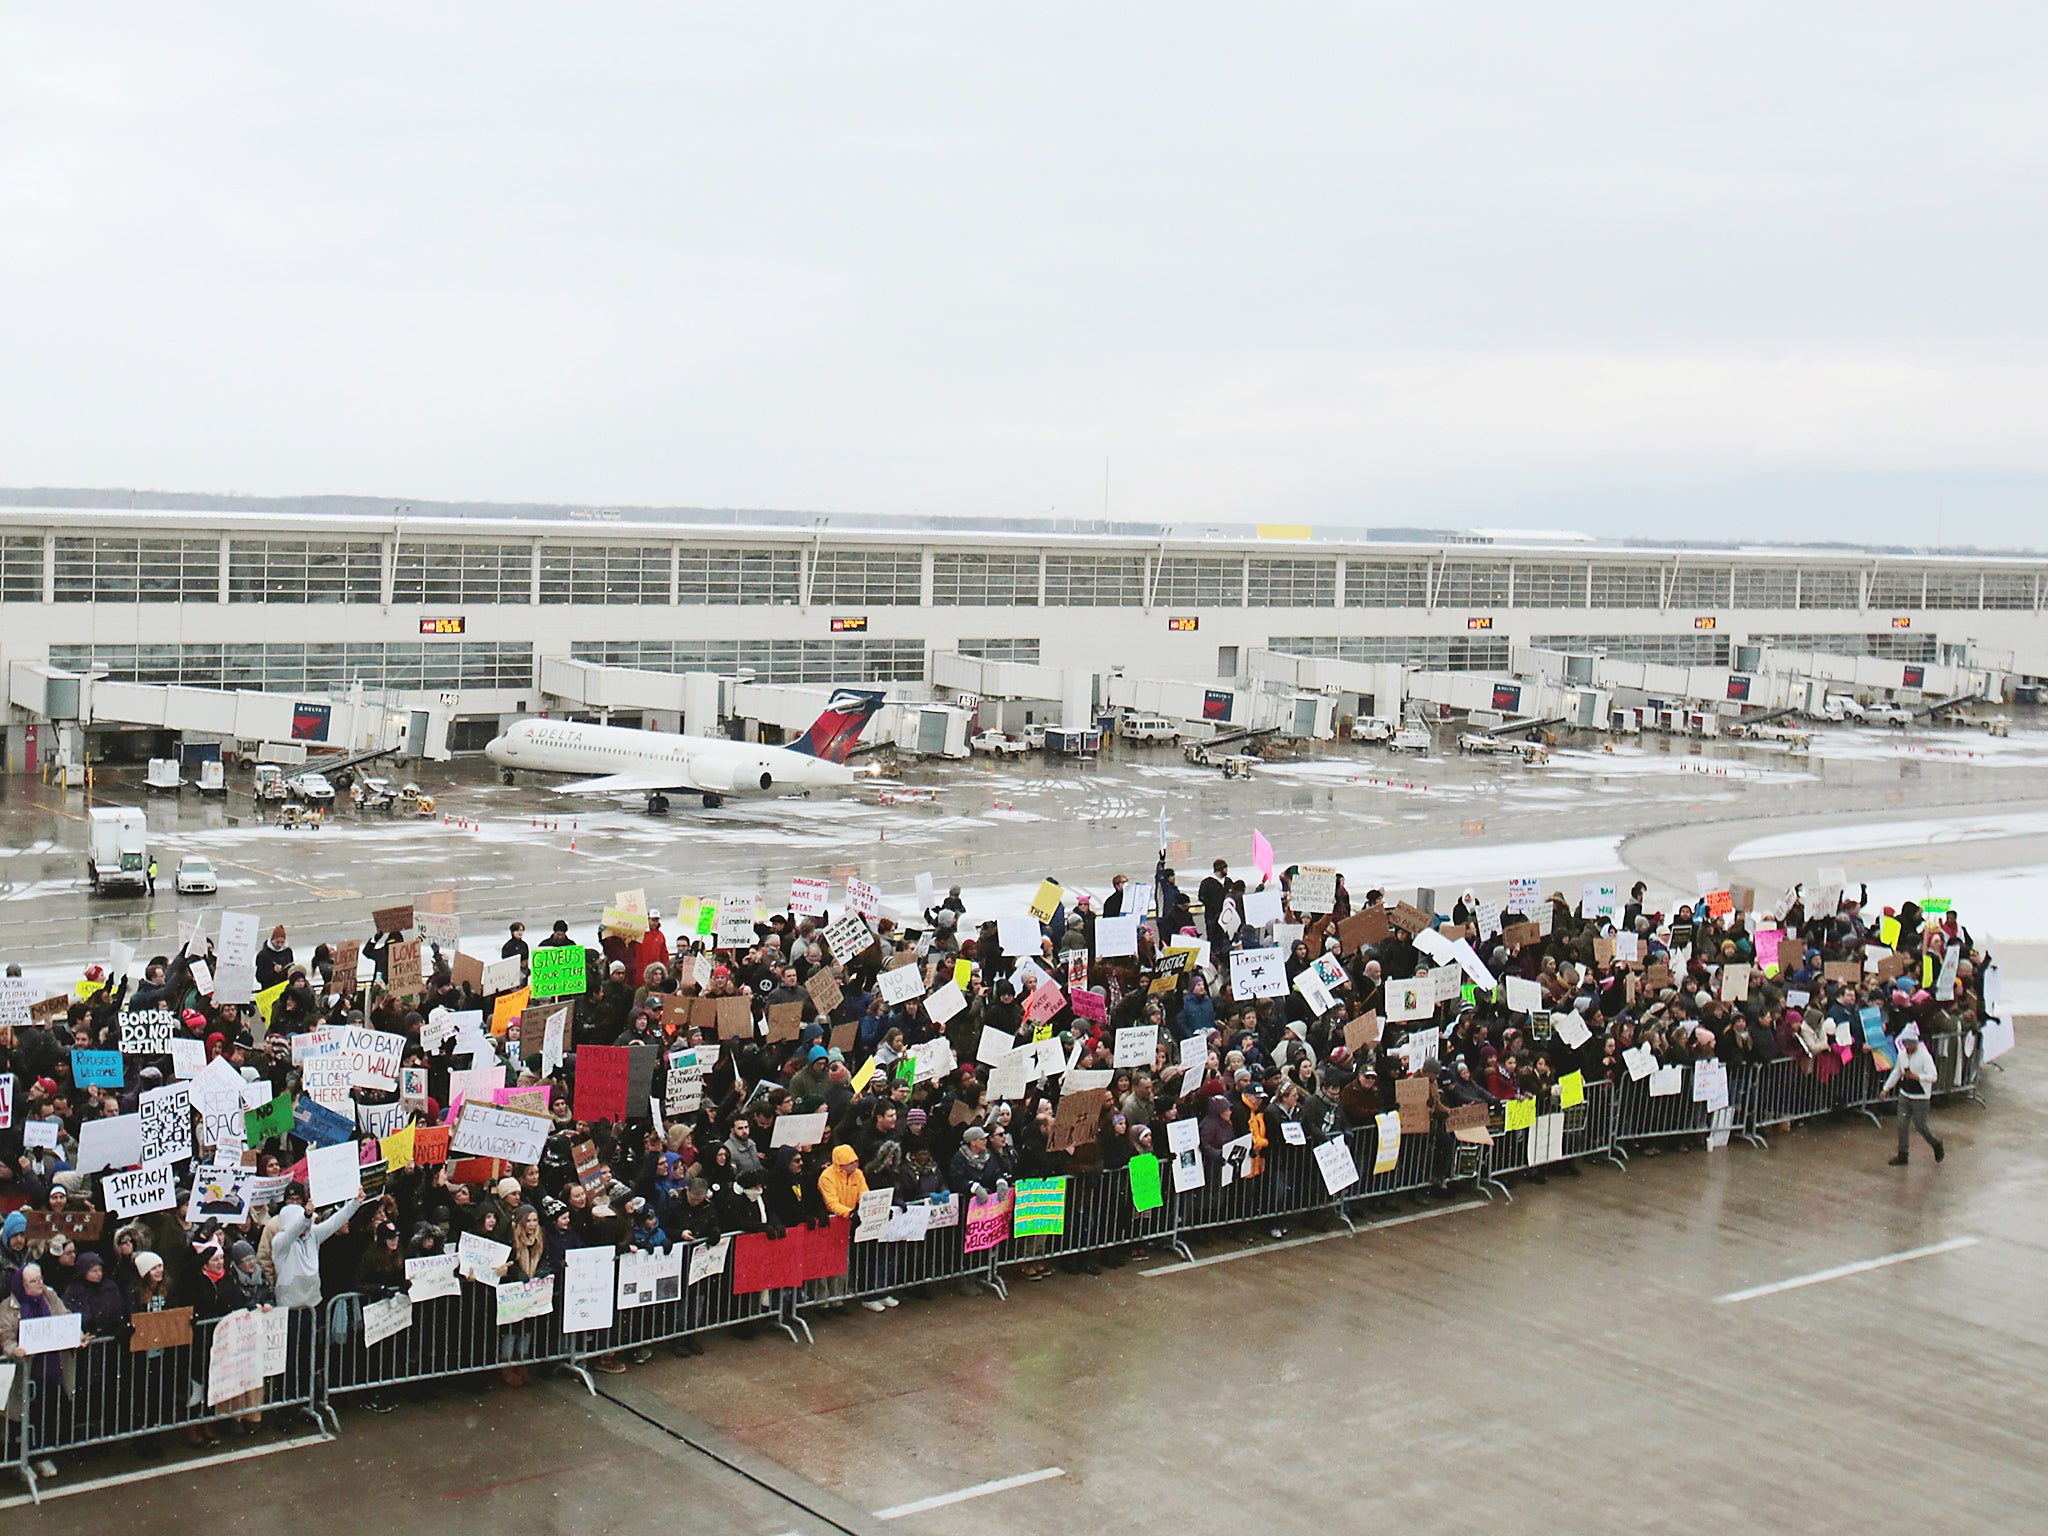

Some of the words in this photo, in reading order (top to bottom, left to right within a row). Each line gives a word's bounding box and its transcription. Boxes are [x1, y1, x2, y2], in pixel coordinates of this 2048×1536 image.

[440, 693, 459, 705] A49
[960, 695, 977, 706] A51
[538, 728, 583, 743] DELTA
[857, 882, 871, 892] OUR
[724, 896, 751, 906] Latinx
[792, 890, 810, 899] MAKE
[814, 894, 822, 902] US
[847, 886, 879, 904] COUNTRY
[790, 903, 812, 912] GREAT
[1030, 905, 1051, 920] THIS!
[393, 940, 421, 962] LOVE
[532, 949, 564, 969] GIVE
[1155, 953, 1188, 973] JUSTICE
[1230, 953, 1276, 966] TARGETING
[885, 973, 902, 987] NO
[894, 982, 923, 999] BAN
[1239, 980, 1281, 996] SECURITY
[118, 1010, 174, 1026] BORDERS
[121, 1025, 147, 1040] DO
[149, 1024, 174, 1039] NOT
[312, 1032, 331, 1044] HATE
[320, 1042, 341, 1054] FEAR
[346, 1031, 372, 1049] NO
[374, 1035, 404, 1056] BAN
[77, 1051, 117, 1065] REFUGEES
[308, 1058, 352, 1071] REFUGEES
[81, 1068, 117, 1078] WELCOME
[367, 1055, 398, 1079] WALL
[304, 1072, 352, 1087] WELCOME
[313, 1088, 345, 1103] HERE
[665, 1093, 702, 1104] WELCOMED
[256, 1104, 274, 1122] NO
[463, 1107, 490, 1122] LET
[495, 1109, 539, 1133] LEGAL
[358, 1103, 406, 1139] NEVER
[454, 1131, 526, 1155] IMMIGRANT
[111, 1168, 168, 1194] IMPEACH
[116, 1188, 165, 1208] TRUMP
[267, 1335, 285, 1346] NOT
